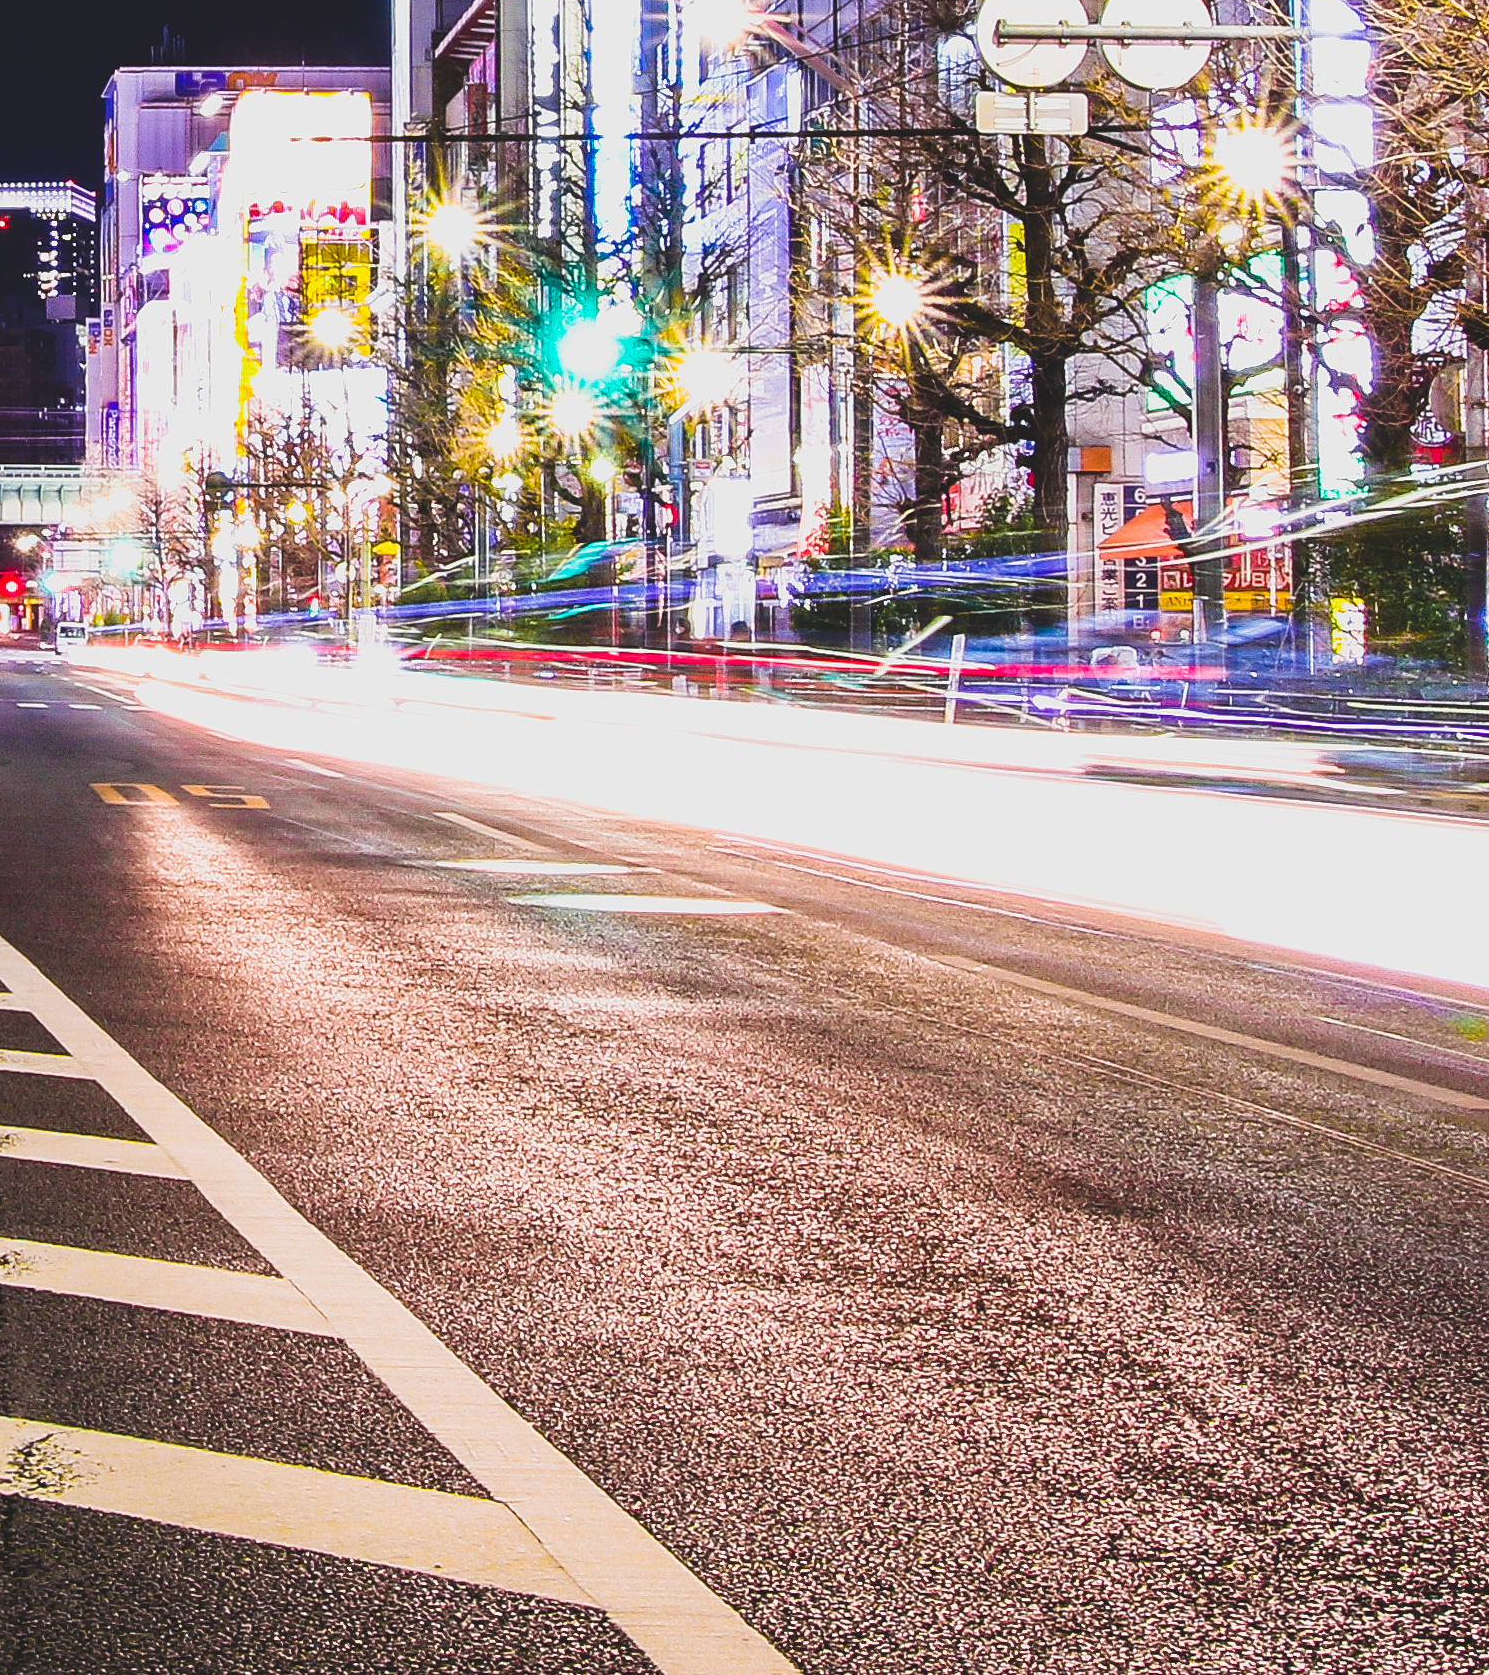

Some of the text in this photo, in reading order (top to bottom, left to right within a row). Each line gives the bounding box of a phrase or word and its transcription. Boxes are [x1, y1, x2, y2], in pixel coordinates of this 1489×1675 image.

[1134, 488, 1146, 504] 6
[1135, 572, 1147, 588] 2
[1138, 593, 1145, 609] 1
